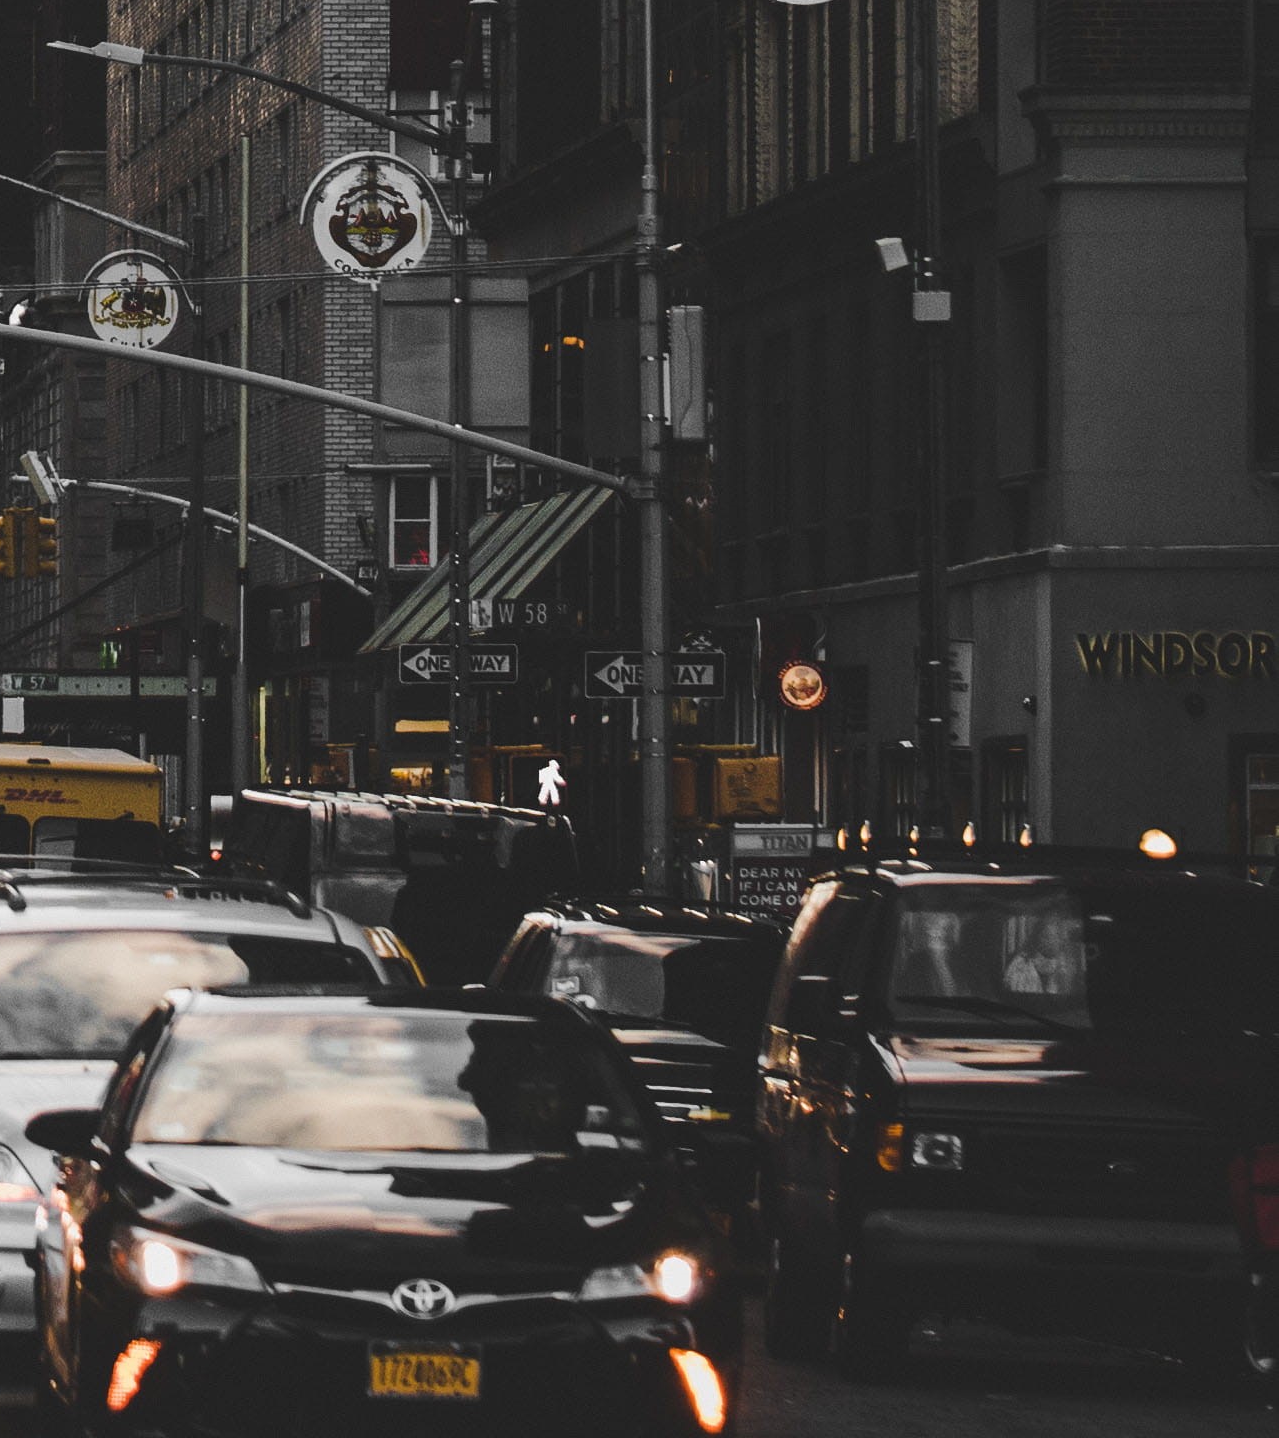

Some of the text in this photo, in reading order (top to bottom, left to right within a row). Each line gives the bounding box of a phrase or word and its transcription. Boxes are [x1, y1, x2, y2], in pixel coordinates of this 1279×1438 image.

[497, 602, 515, 624] W
[525, 602, 547, 625] 58
[1075, 630, 1278, 678] WINDSOR
[415, 655, 506, 672] ONE WAY
[30, 676, 46, 690] 57
[4, 788, 63, 803] DHL
[762, 834, 809, 850] TITAN
[739, 867, 780, 879] DEAR
[739, 880, 752, 893] IF
[765, 880, 798, 892] CAN
[739, 895, 782, 907] COME
